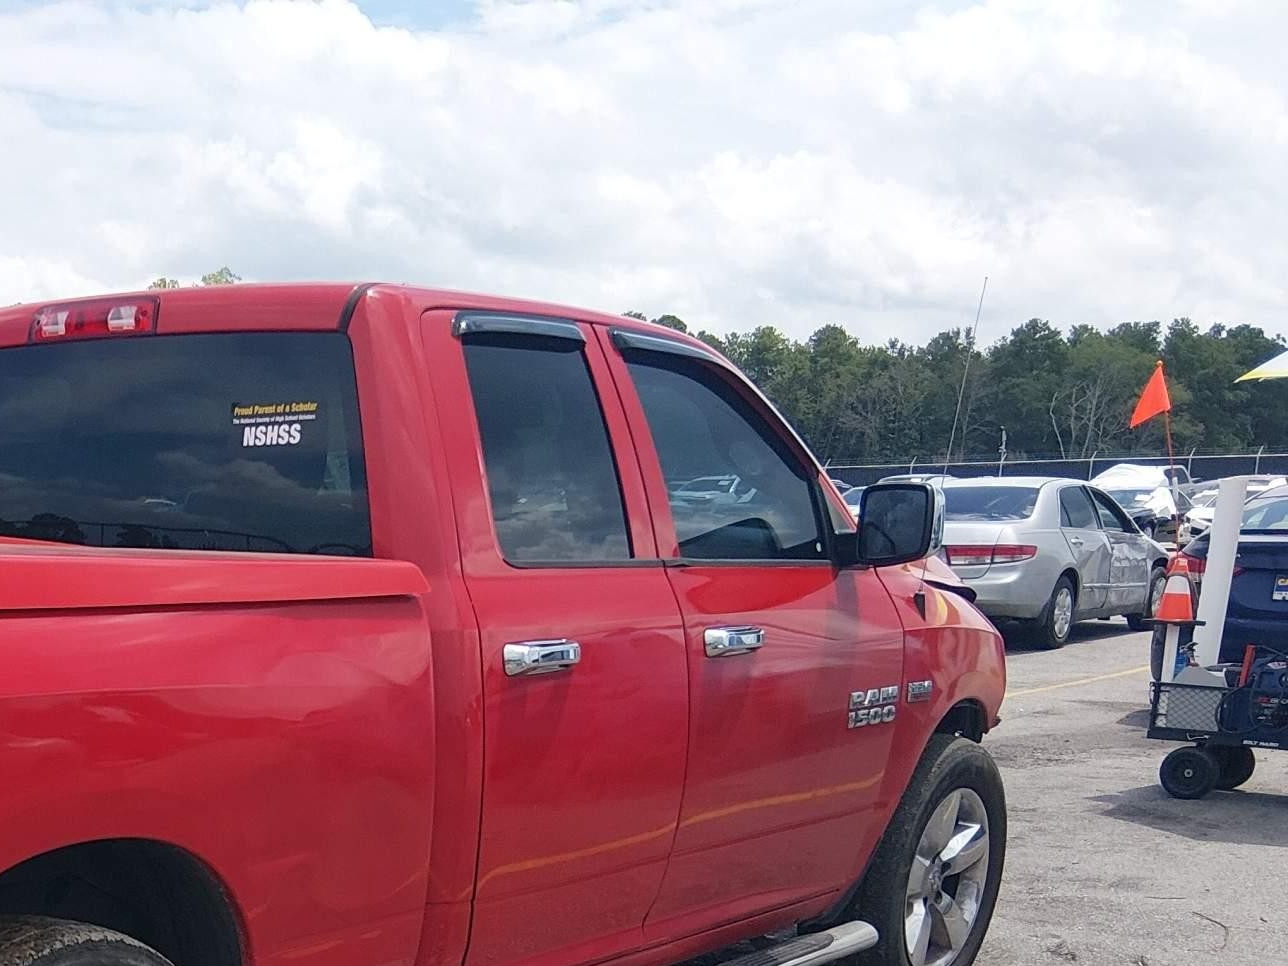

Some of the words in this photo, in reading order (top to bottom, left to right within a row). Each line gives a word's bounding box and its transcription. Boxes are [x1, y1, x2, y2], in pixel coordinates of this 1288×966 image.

[234, 406, 253, 416] Proud
[254, 404, 276, 415] Parent
[277, 403, 285, 413] of
[291, 402, 318, 412] Scholar
[243, 424, 301, 446] NSHSS
[850, 686, 898, 708] RAM
[848, 705, 896, 729] 1500
